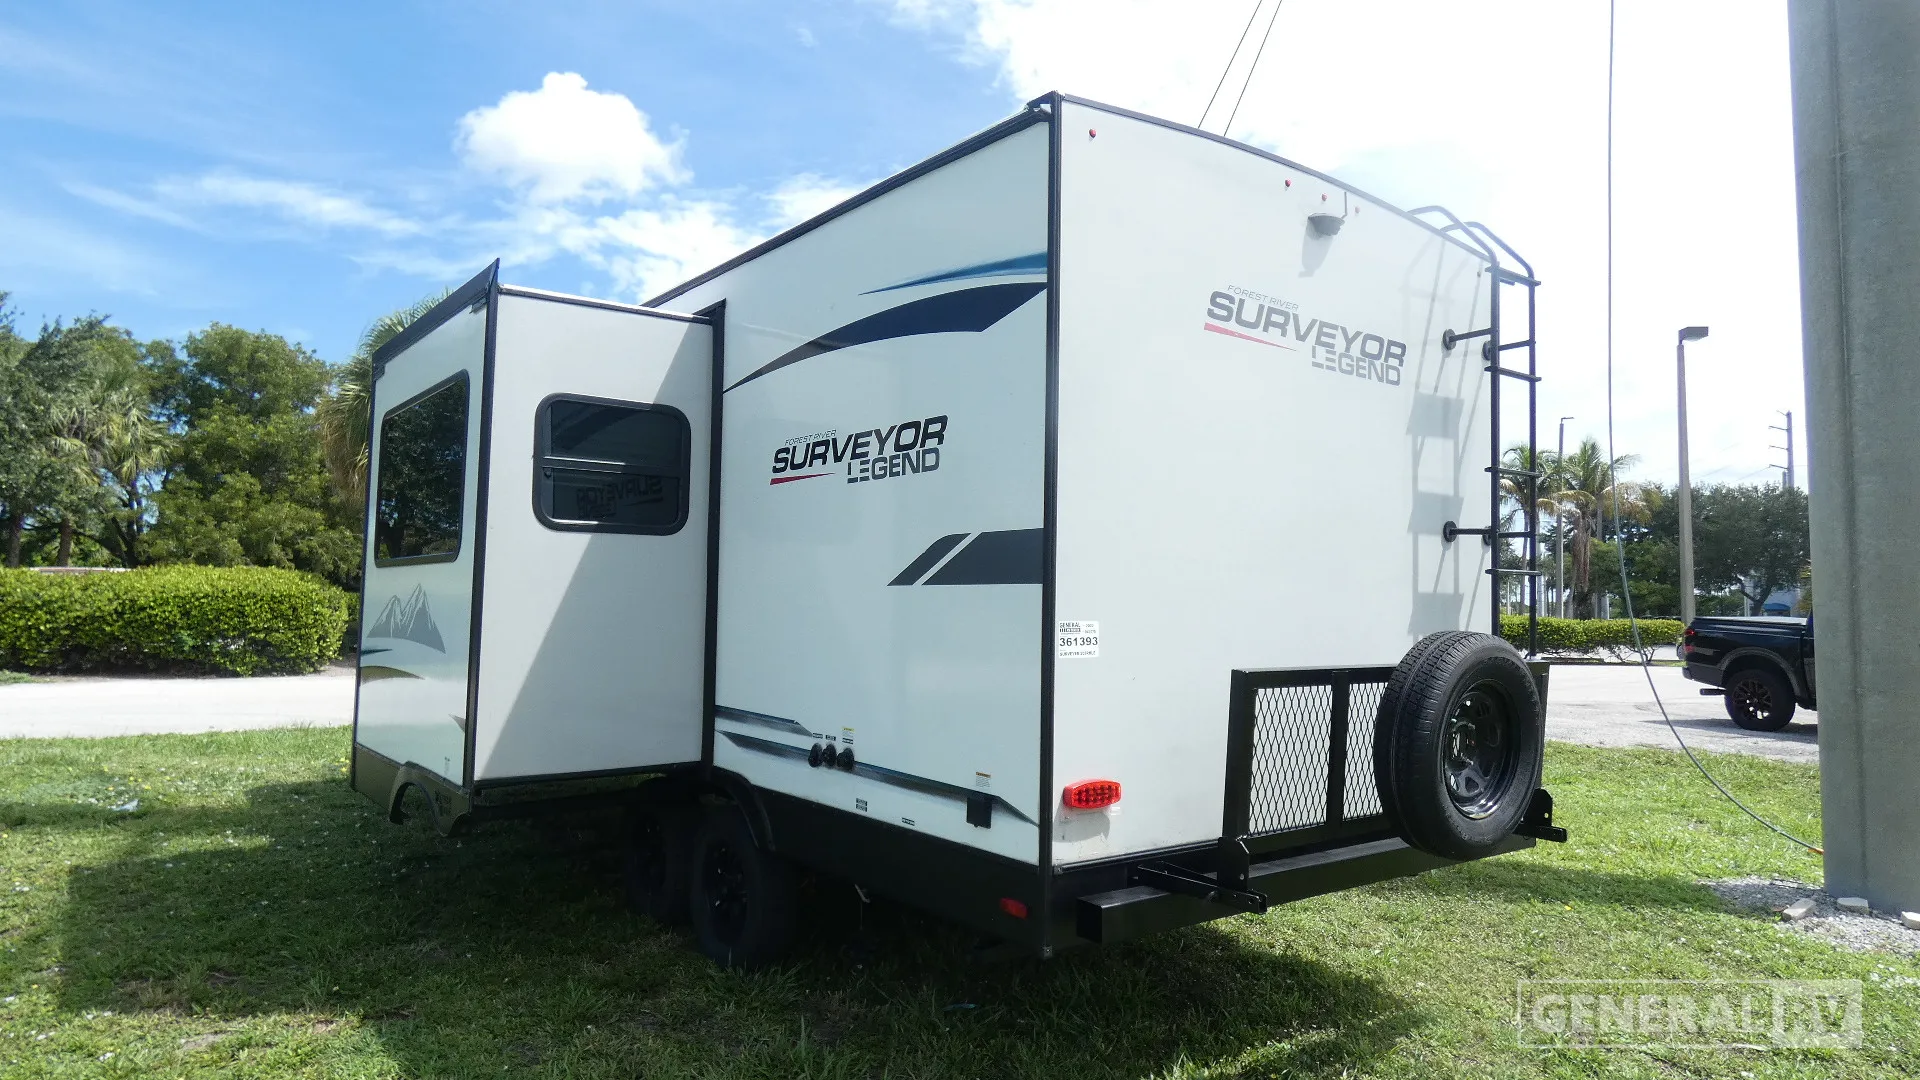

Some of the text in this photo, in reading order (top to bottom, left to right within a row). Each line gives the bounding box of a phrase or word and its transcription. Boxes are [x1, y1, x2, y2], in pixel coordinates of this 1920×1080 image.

[1227, 285, 1299, 311] FOREST RIVER
[1207, 291, 1407, 367] SURVEYOR
[1311, 345, 1401, 386] LEGEND
[772, 415, 948, 474] SURVEYOR
[785, 429, 837, 446] FOREST RIVER
[847, 447, 940, 484] LEGEND
[1059, 637, 1098, 647] 361393
